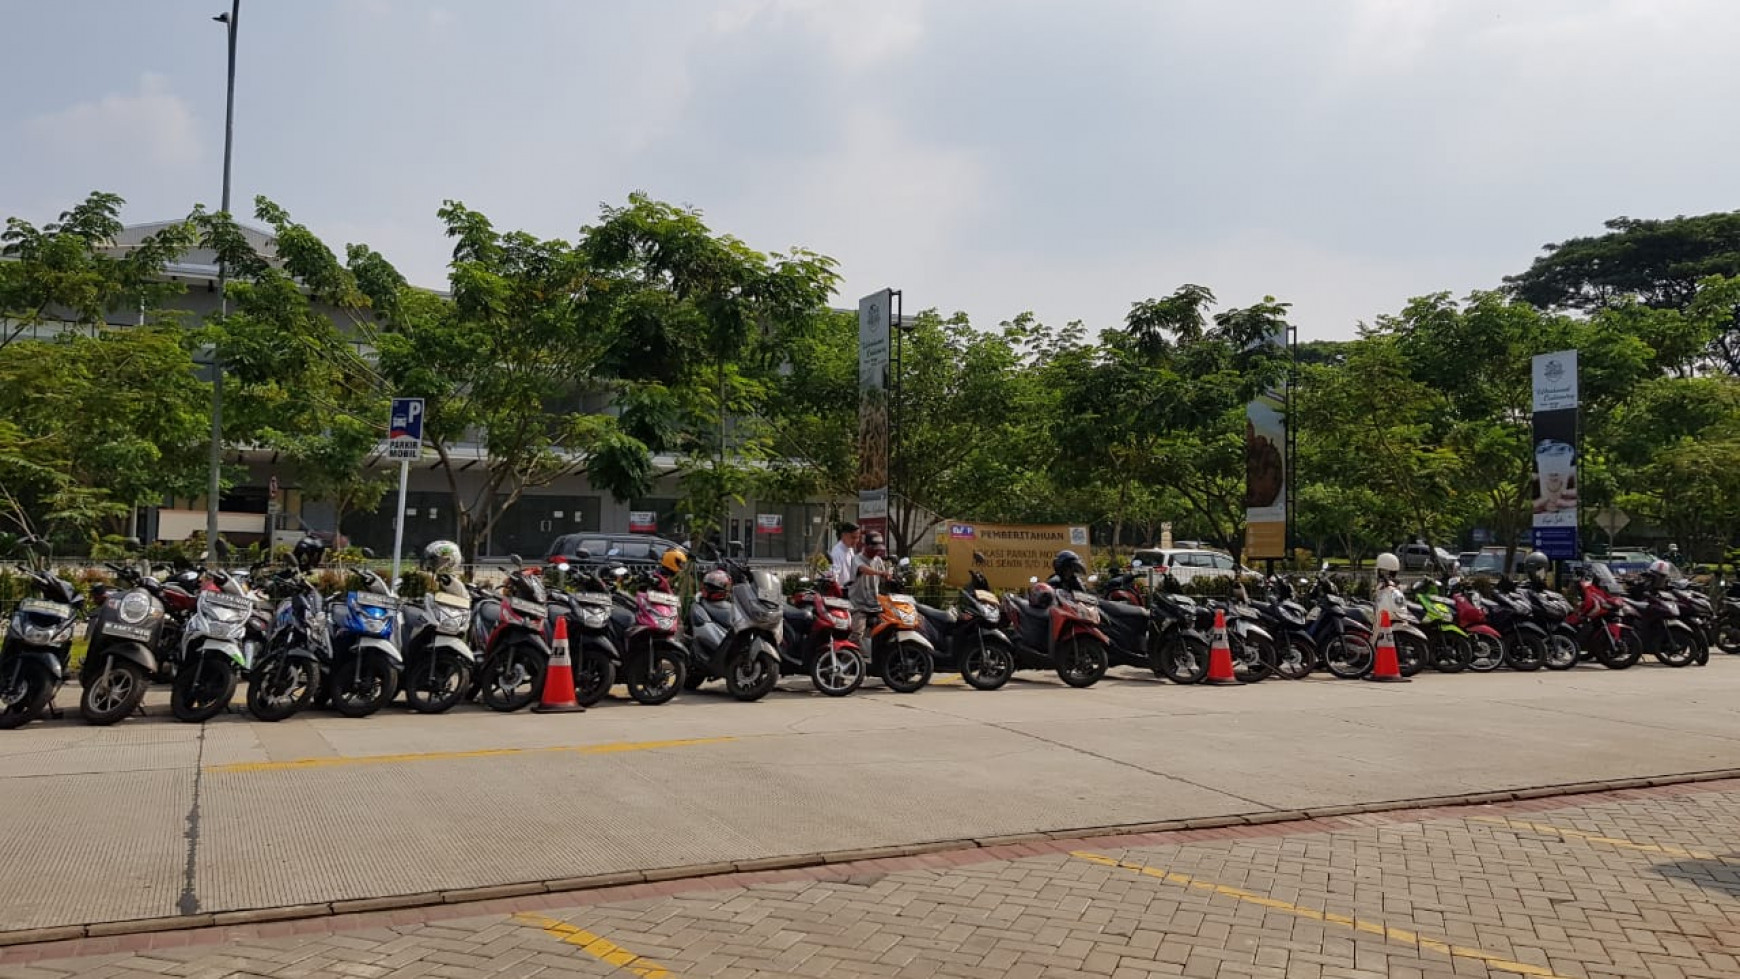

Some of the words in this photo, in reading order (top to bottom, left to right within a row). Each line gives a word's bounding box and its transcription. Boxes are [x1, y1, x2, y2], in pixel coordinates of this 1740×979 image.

[408, 401, 421, 424] P
[389, 441, 418, 449] PARKIR
[389, 449, 417, 457] MOBIL
[981, 530, 1064, 540] PEMBERITAHUAN
[1006, 549, 1038, 559] PARKIR
[996, 559, 1023, 568] SENIN
